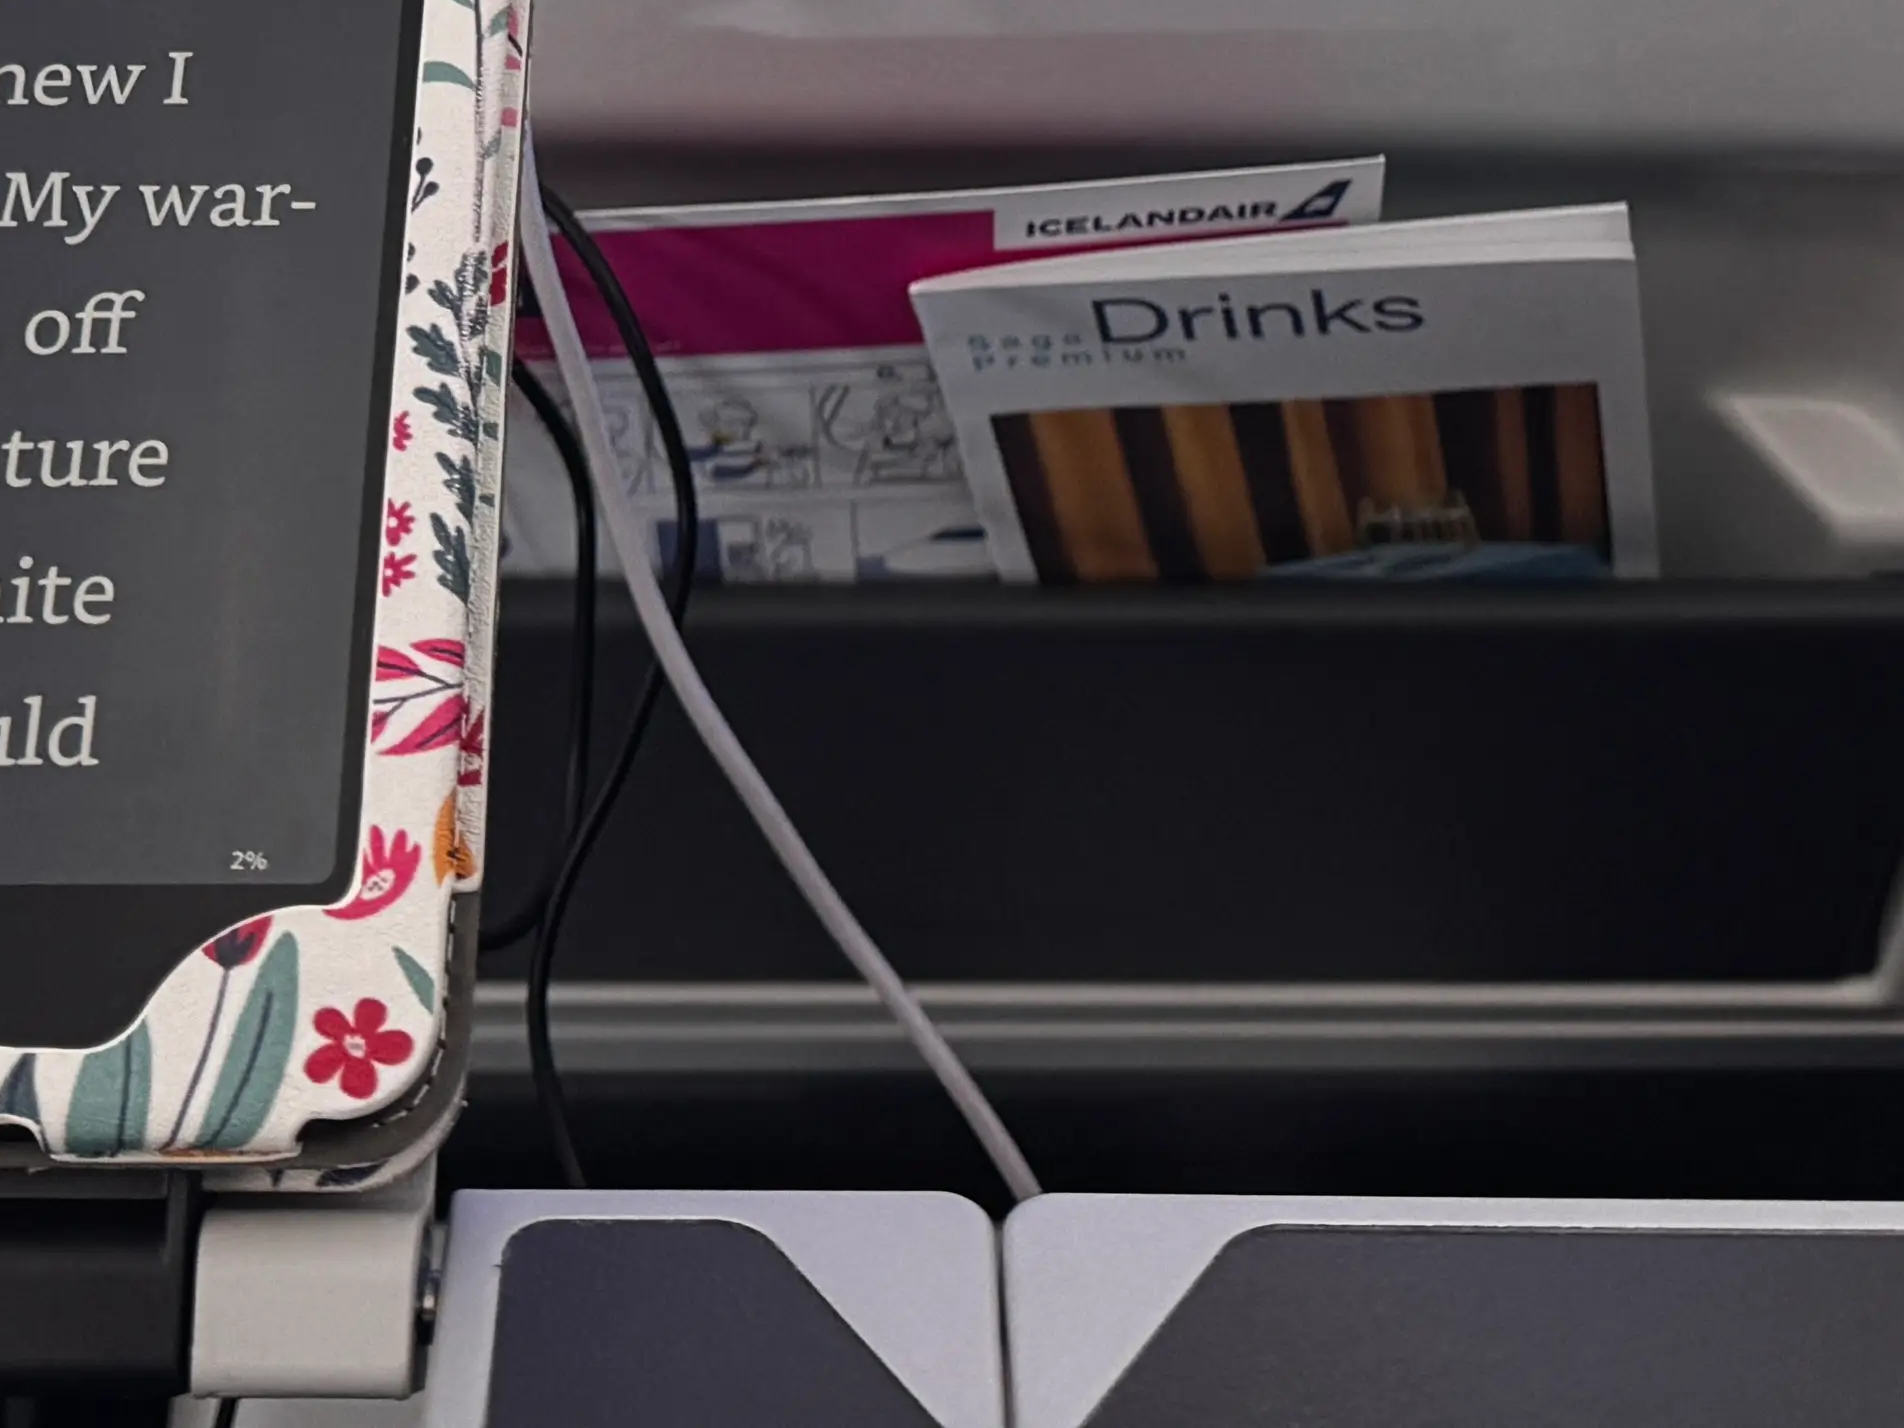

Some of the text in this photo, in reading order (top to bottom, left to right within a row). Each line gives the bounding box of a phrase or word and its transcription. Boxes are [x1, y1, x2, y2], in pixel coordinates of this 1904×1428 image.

[163, 52, 193, 104] I
[139, 184, 316, 227] war-
[1026, 200, 1277, 238] ICELANDAIR
[25, 290, 145, 355] off
[1092, 289, 1425, 344] Drinks
[231, 851, 267, 870] 2%
